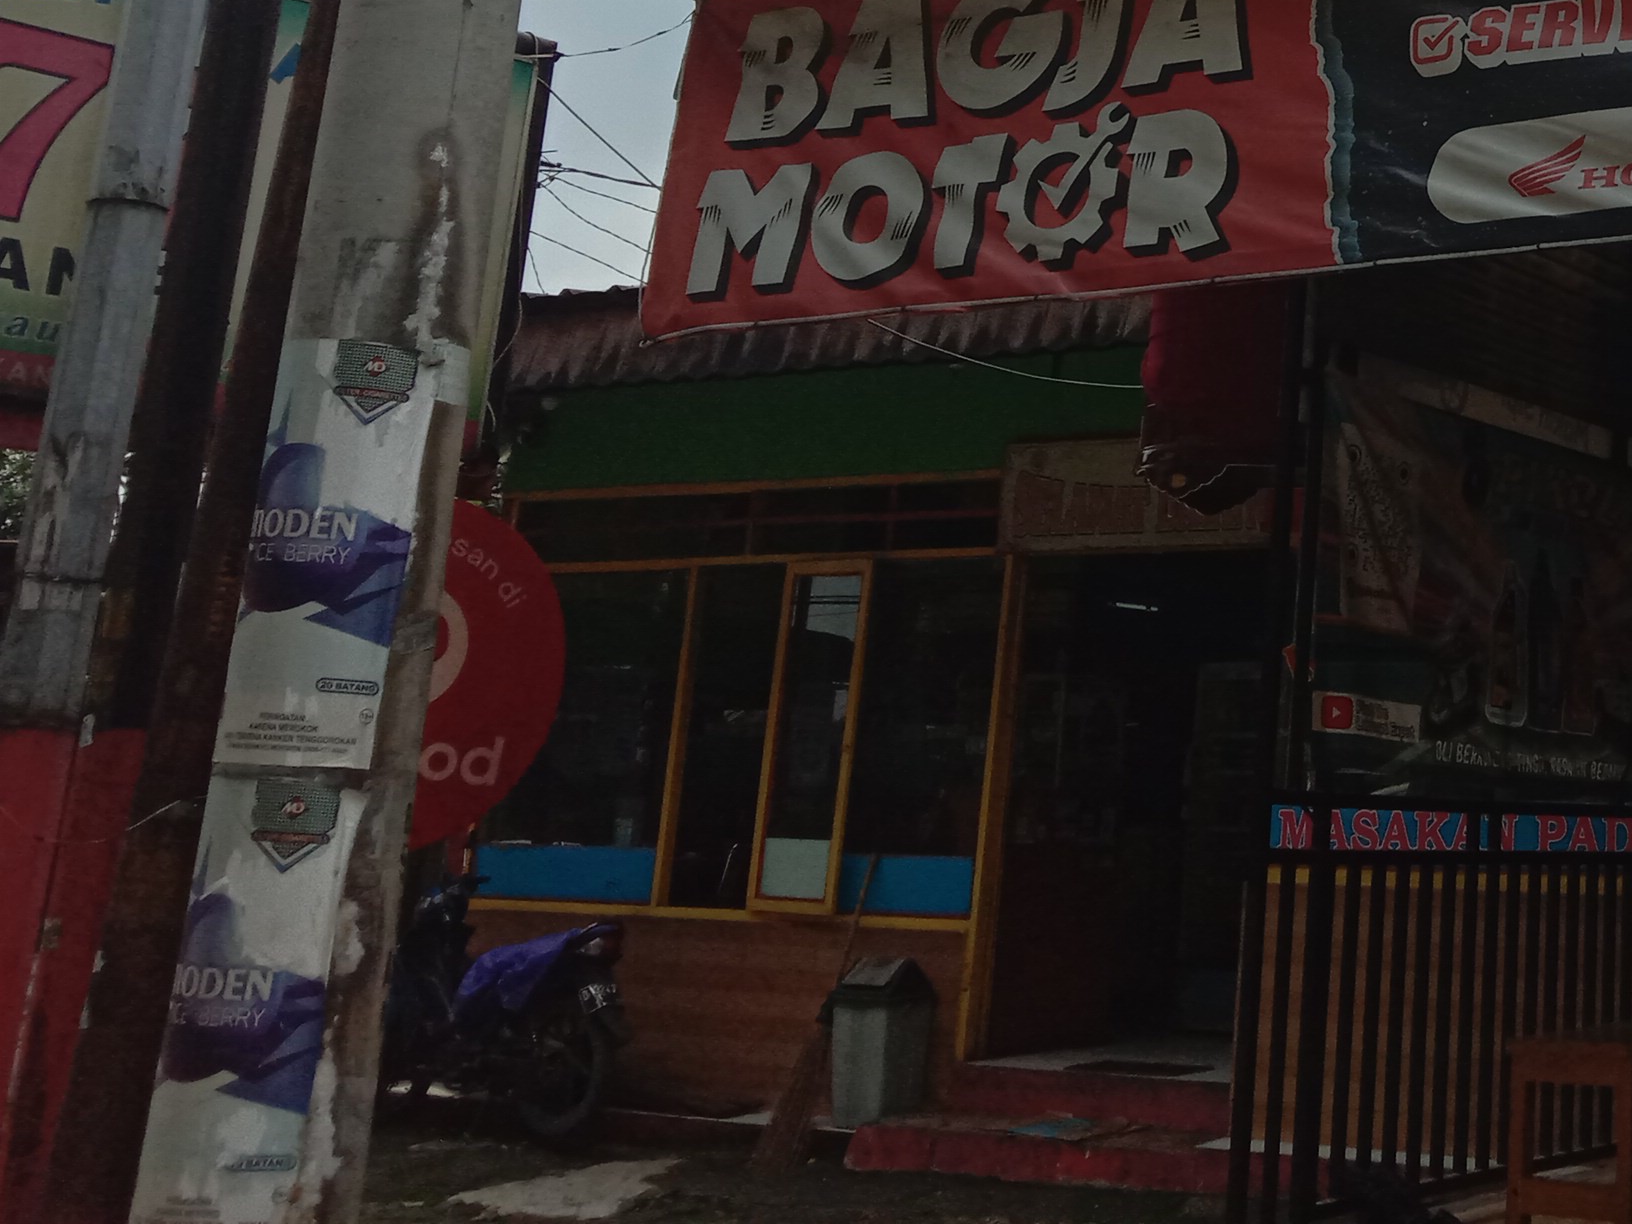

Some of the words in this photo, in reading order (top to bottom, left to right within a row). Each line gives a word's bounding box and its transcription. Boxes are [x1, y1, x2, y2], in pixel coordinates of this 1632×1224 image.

[685, 104, 1237, 301] MOTOR
[284, 543, 352, 565] BERRY
[498, 582, 528, 609] di
[194, 1005, 266, 1028] BERRY
